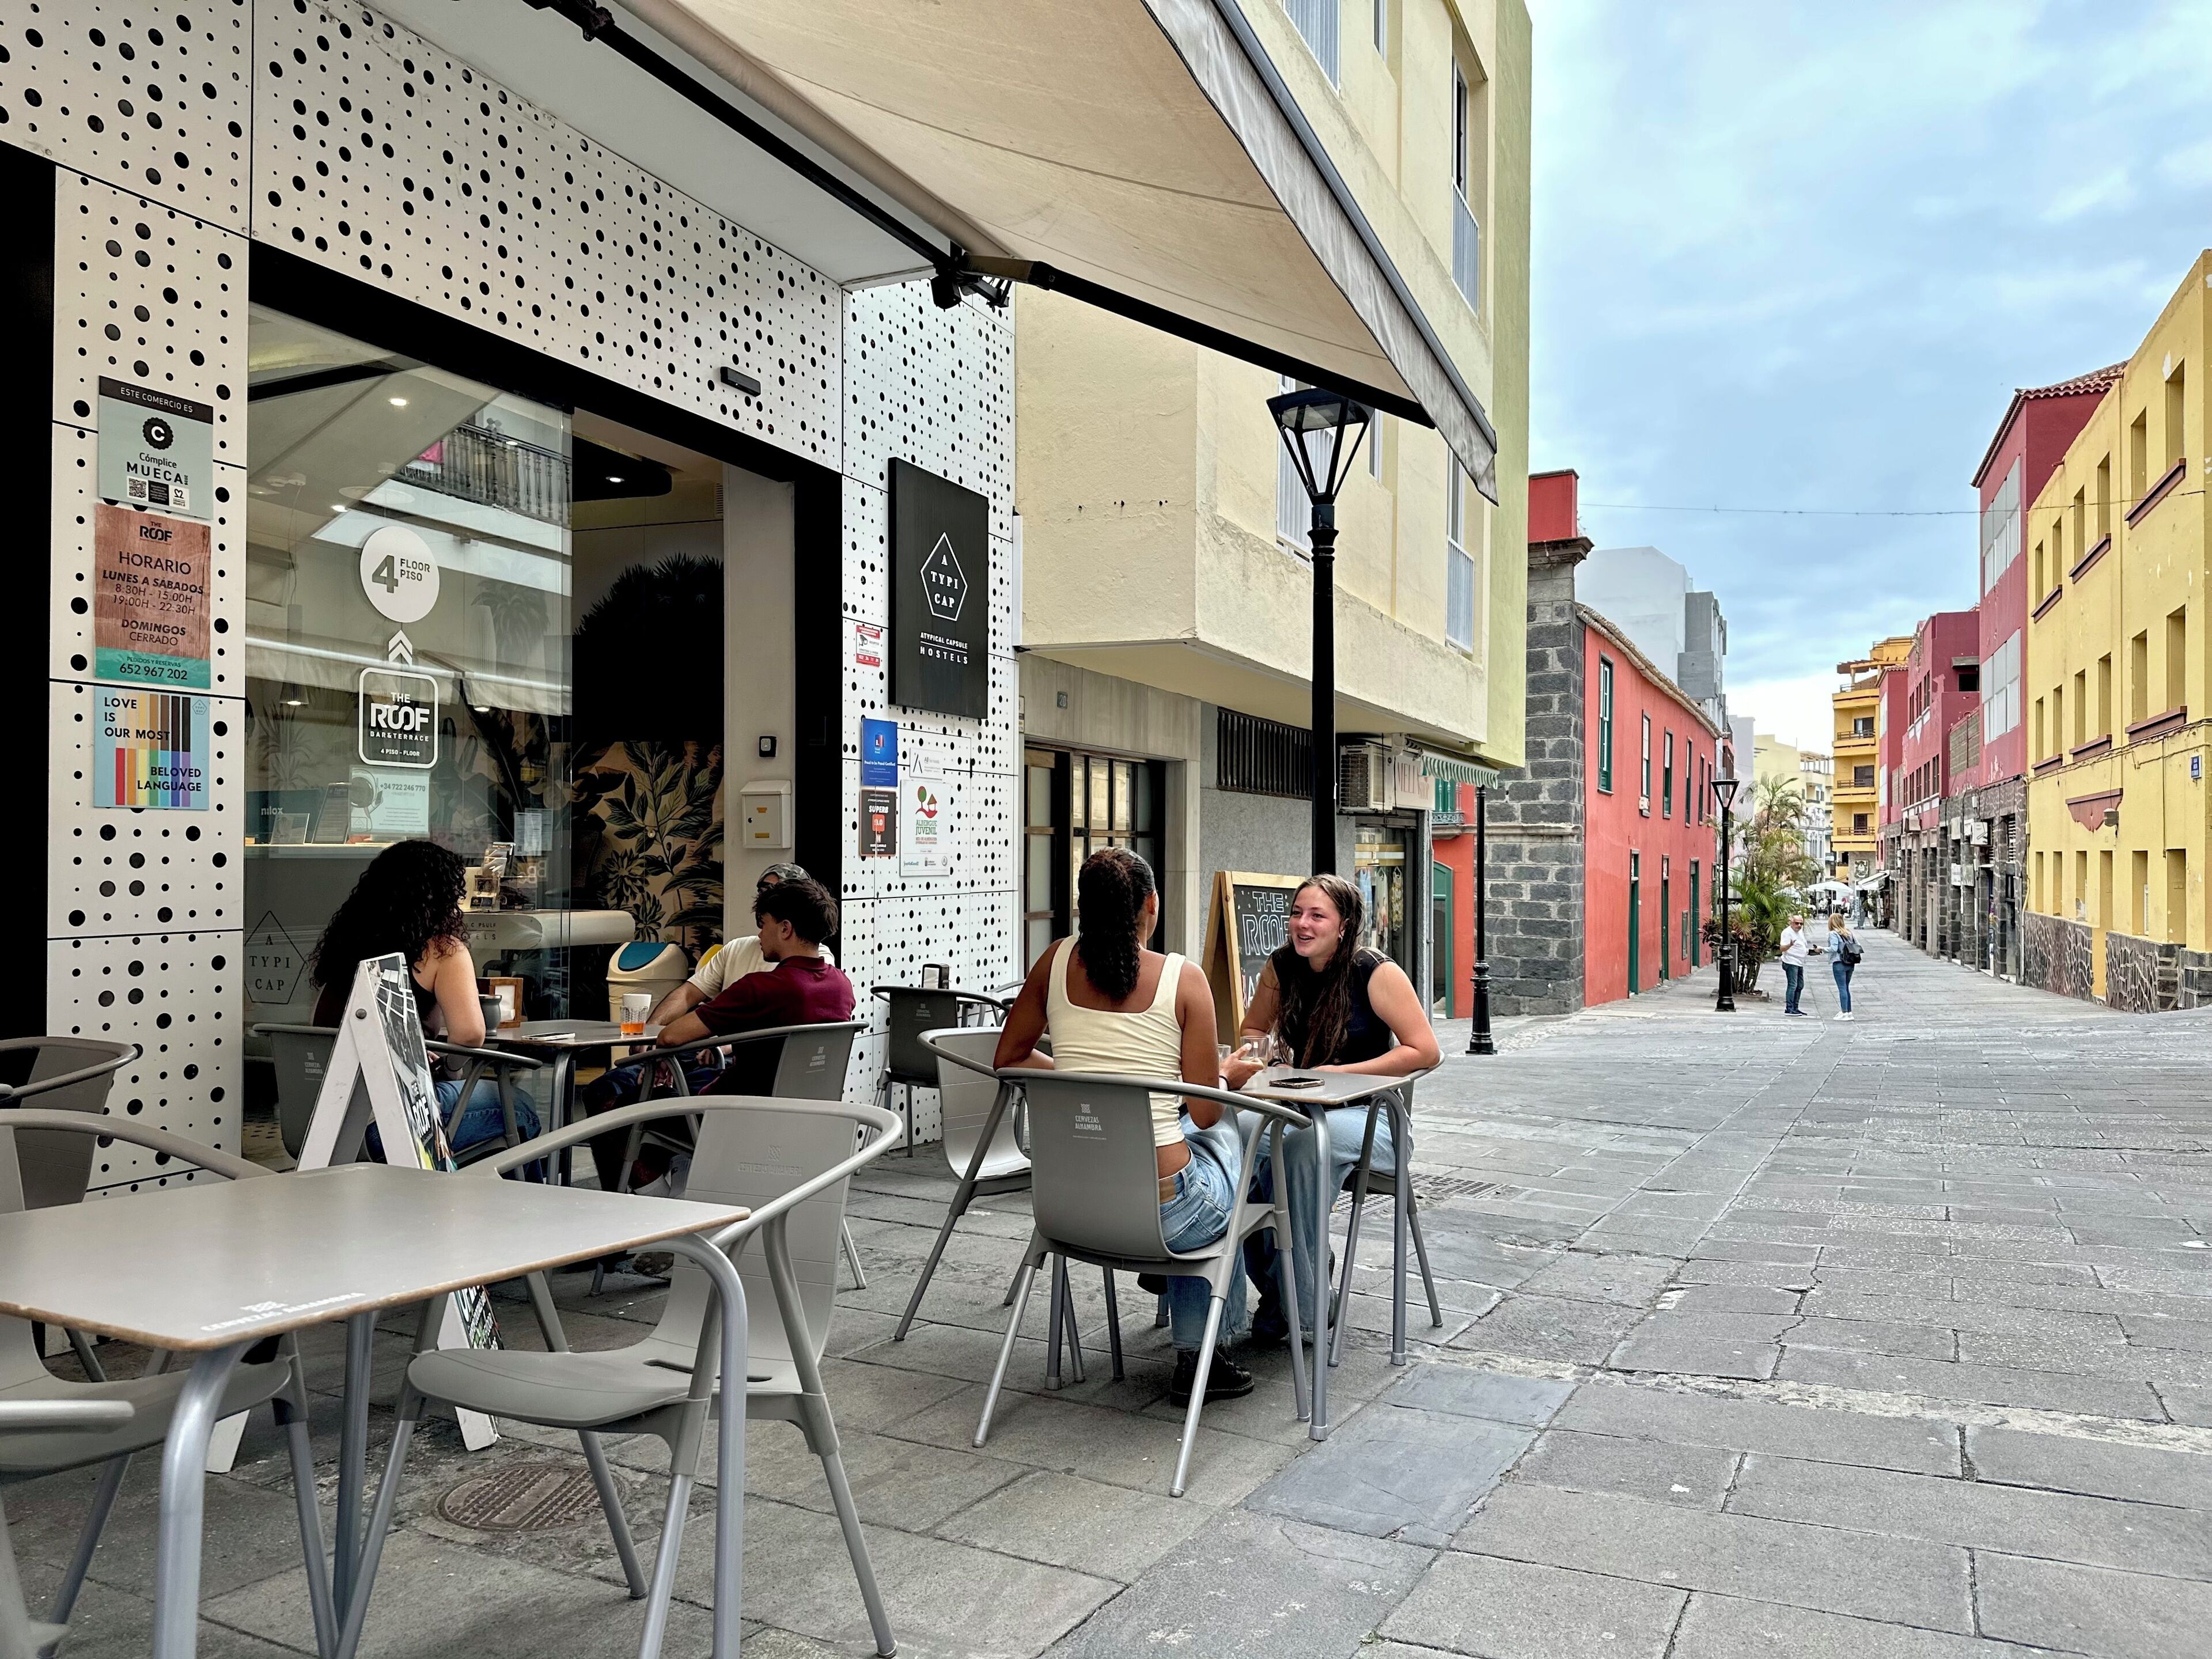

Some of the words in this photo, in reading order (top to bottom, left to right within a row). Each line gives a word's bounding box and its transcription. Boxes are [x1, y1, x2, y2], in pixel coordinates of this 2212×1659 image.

[120, 387, 140, 399] ESTE
[142, 393, 181, 410] COMERCIO
[183, 404, 194, 413] ES
[151, 426, 165, 441] C
[139, 452, 177, 468] Cómplice
[126, 461, 183, 484] MUECA
[139, 525, 172, 542] ROOF
[119, 551, 191, 575] HORARIO
[400, 558, 430, 573] FLOOR
[941, 554, 948, 566] A
[103, 569, 138, 584] LUNES
[141, 577, 149, 586] A
[372, 554, 399, 594] 4
[400, 569, 422, 581] PISO
[930, 570, 959, 590] TYPI
[115, 584, 146, 596] 8:30H
[158, 590, 192, 604] 15:00H
[934, 593, 955, 608] CAP
[113, 594, 149, 608] 19:00H
[159, 602, 195, 615] 22:30H
[121, 619, 186, 636] DOMINGOS
[130, 632, 179, 646] CERRADO
[920, 631, 945, 644] ATYPICAL
[946, 637, 968, 650] CAPSULE
[920, 645, 968, 665] HOSTELS
[119, 663, 141, 675] 652
[143, 666, 165, 677] 967
[167, 668, 188, 680] 202
[104, 696, 137, 709] LOVE
[391, 692, 411, 703] THE
[1059, 694, 1066, 707] 20
[104, 712, 116, 722] IS
[370, 703, 430, 732] ROOF
[104, 727, 130, 738] OUR
[135, 729, 171, 741] MOST
[150, 766, 202, 778] BELOVED
[137, 780, 202, 791] LANGUAGE
[261, 806, 283, 816] nilox
[868, 805, 889, 813] SUPERB
[915, 826, 937, 835] JUVENIL
[1252, 891, 1285, 912] THE
[266, 934, 274, 945] A
[249, 956, 290, 968] TYPI
[255, 979, 285, 990] CAP
[1075, 1115, 1099, 1123] CERVEZAS
[1075, 1123, 1102, 1131] ALHAMBRA
